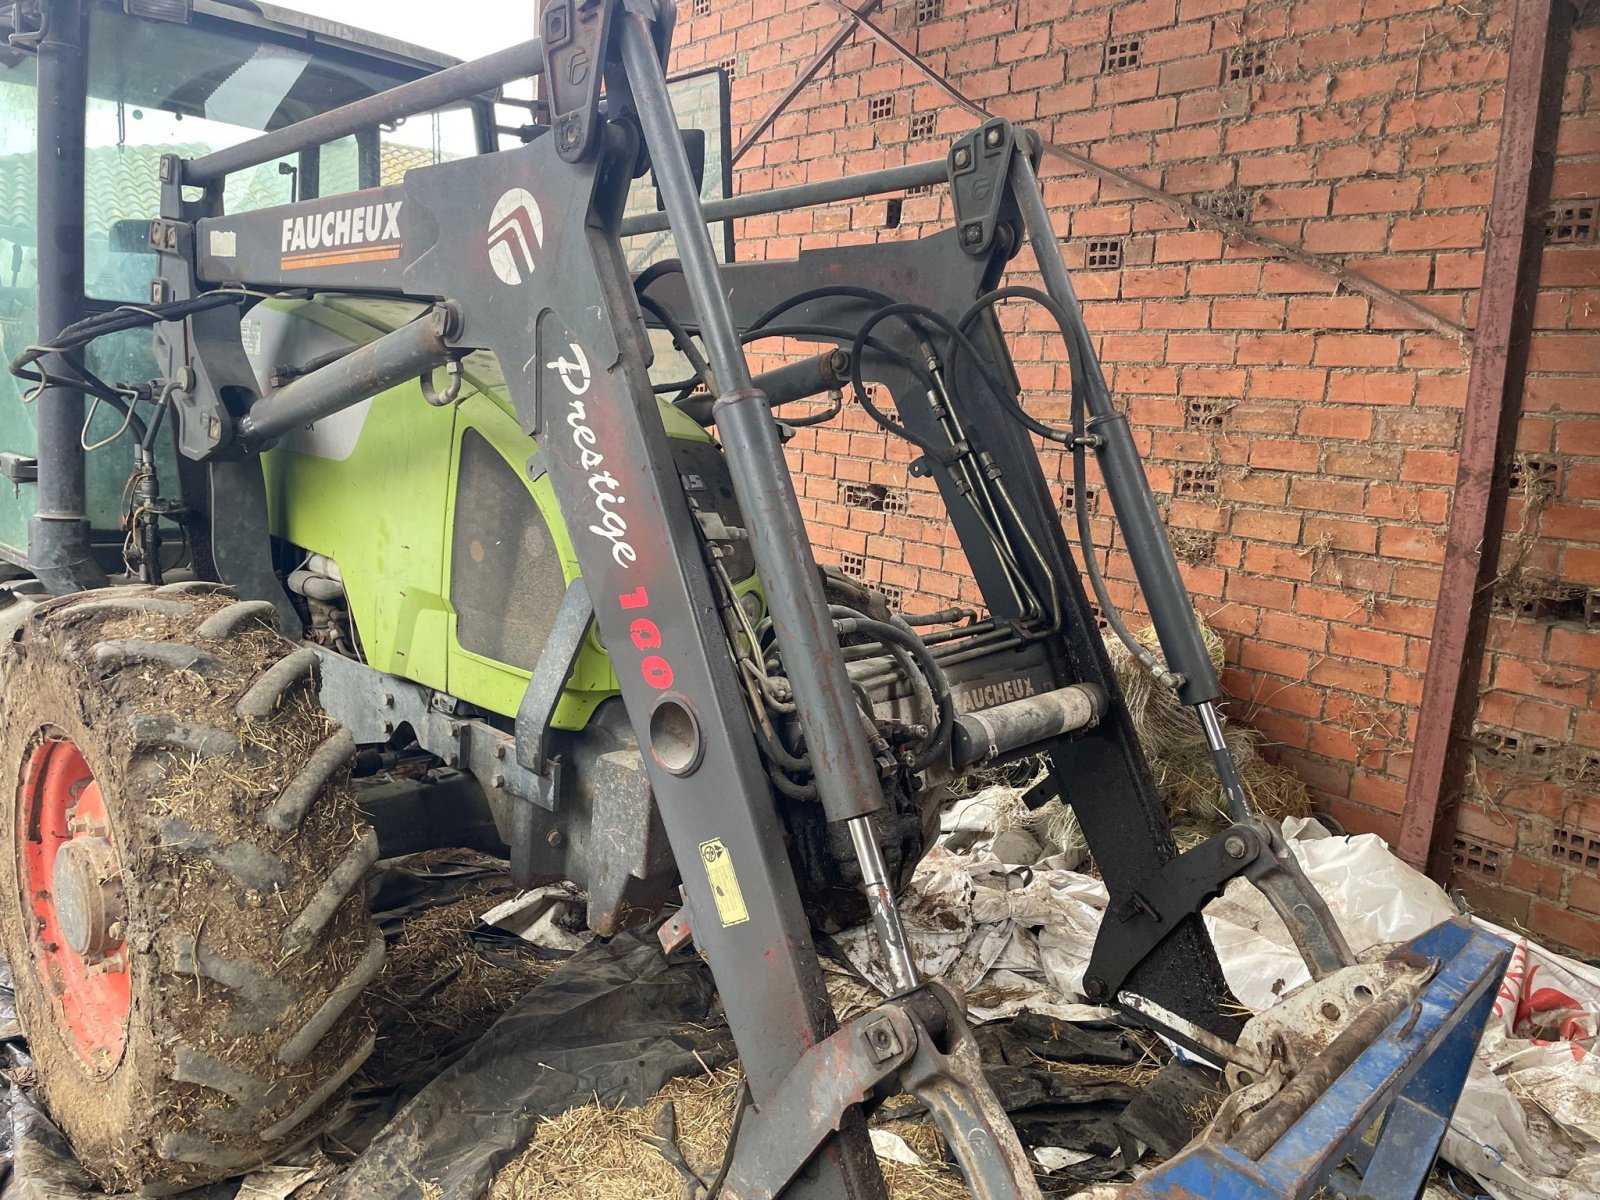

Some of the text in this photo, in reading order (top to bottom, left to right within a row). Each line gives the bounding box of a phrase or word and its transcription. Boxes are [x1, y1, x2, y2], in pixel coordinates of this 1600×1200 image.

[281, 201, 403, 252] FAUCHEUX
[546, 343, 674, 690] Prestige 100
